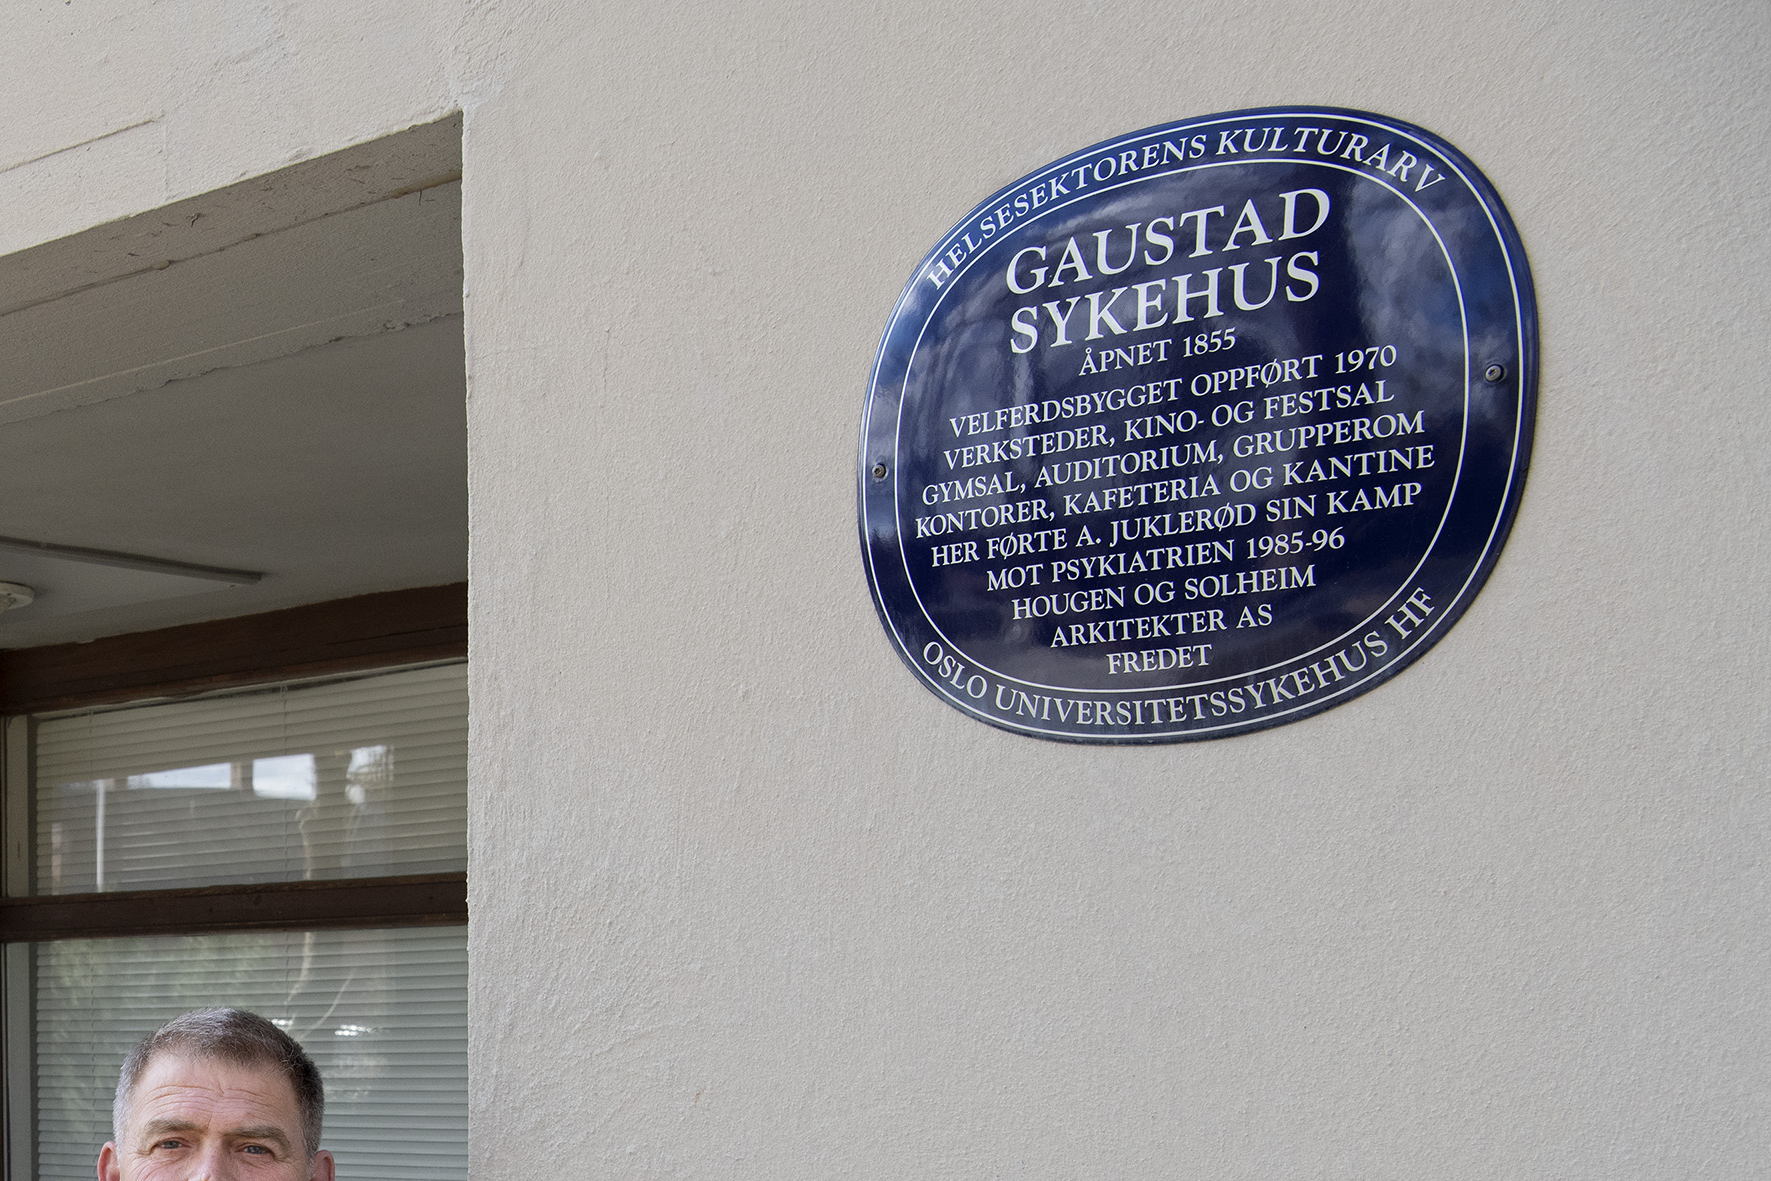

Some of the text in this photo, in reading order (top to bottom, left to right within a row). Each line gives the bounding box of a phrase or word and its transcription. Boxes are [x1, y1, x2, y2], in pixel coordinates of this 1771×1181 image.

[927, 127, 1445, 290] HELSESEKTORENS KULTURARV
[1006, 189, 1330, 294] GAUSTAD
[1011, 251, 1319, 353] SYKEHUS
[949, 345, 1396, 437] VELFERDSBYGGET OPPFØRT 1970
[1079, 327, 1235, 376] ÅPNET 1855
[923, 410, 1425, 505] GYMSAL, AUDITORIUM, GRUPPEROM
[943, 380, 1394, 470] VERKSTEDER, KINO- OG FESTSAL
[916, 445, 1435, 538] KONTORER, KAFETERIA OG KANTINE
[931, 483, 1421, 567] HER FØRTE A. JUKLERØD SIN KAMP
[987, 527, 1345, 591] MOT PSYKIATRIEN 1985-96
[1012, 564, 1316, 620] HOUGEN OG SOLHEIM
[922, 587, 1436, 726] OSLO UNIVERSITETSSYKEHUS HF
[1051, 604, 1272, 647] ARKITEKTER AS
[1106, 644, 1212, 674] FREDET
